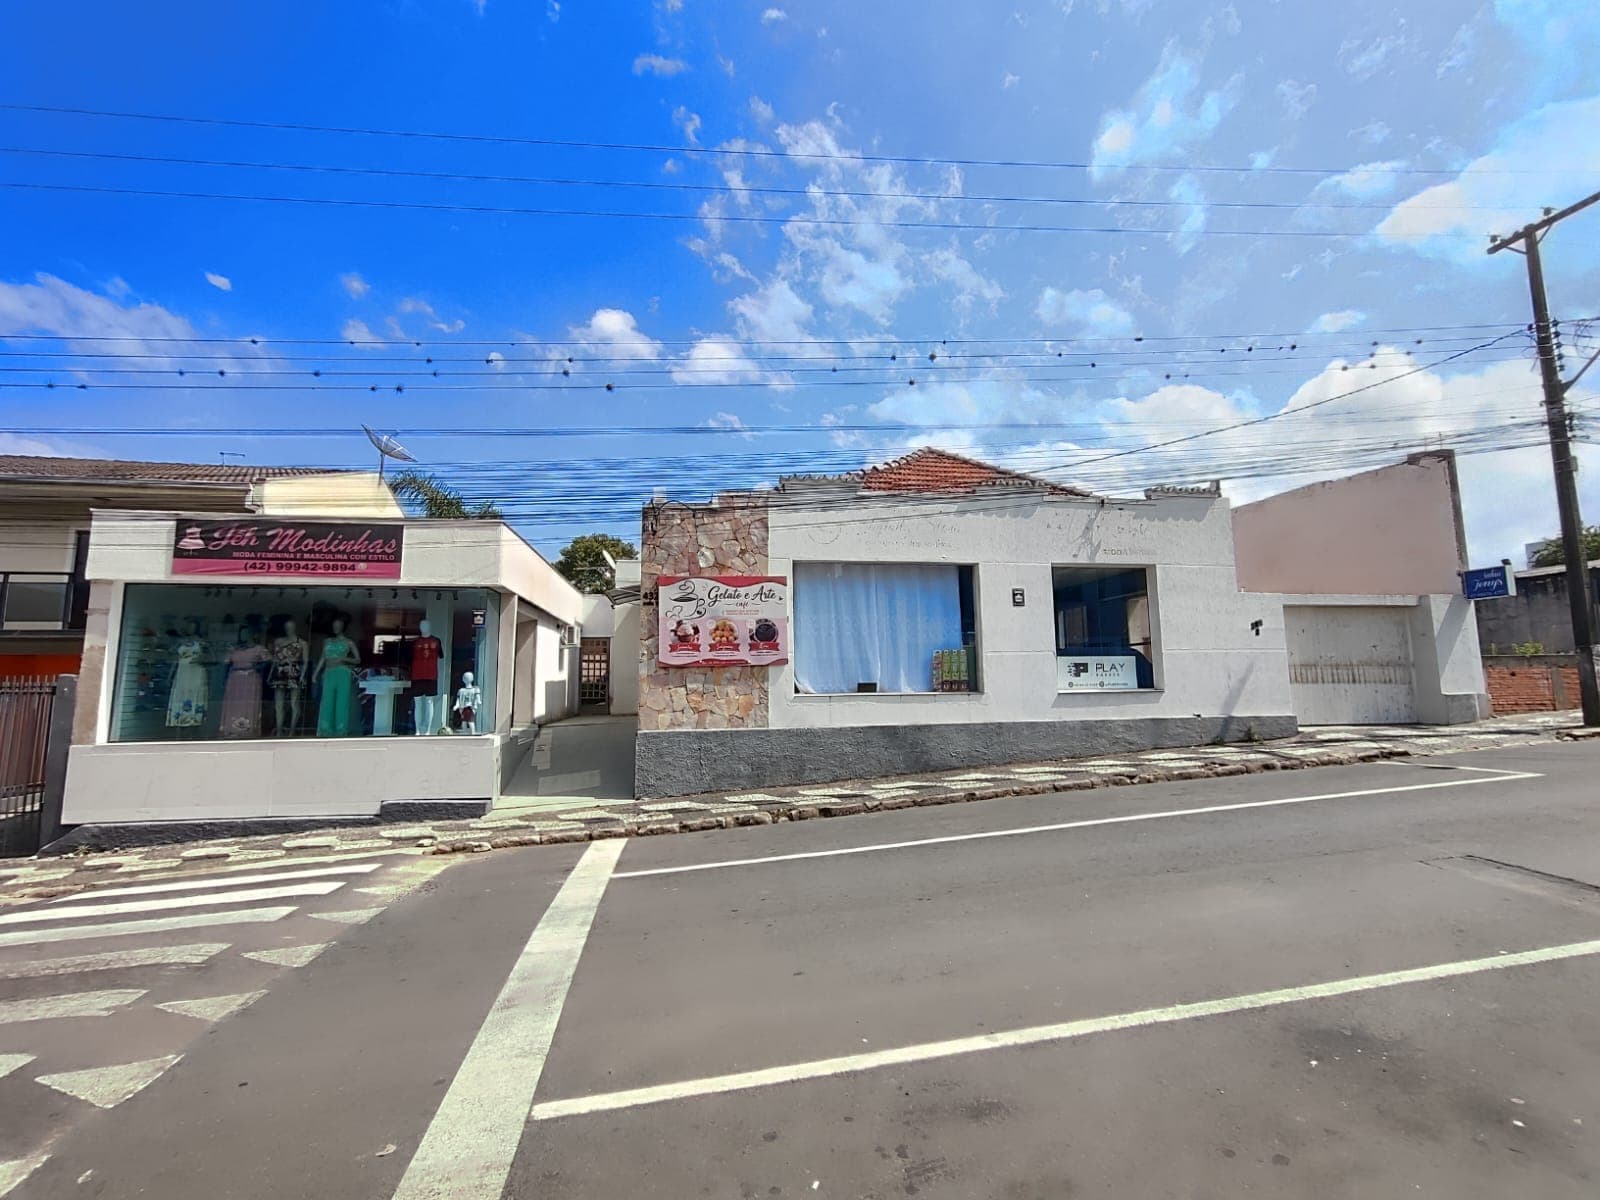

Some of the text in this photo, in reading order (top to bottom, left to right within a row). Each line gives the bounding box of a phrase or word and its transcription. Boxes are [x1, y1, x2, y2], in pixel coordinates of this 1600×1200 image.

[267, 527, 397, 553] Modinhas
[233, 551, 255, 559] MODA
[244, 562, 356, 572] (42) 99942-9894
[708, 585, 777, 607] Gelato e Arte
[1095, 663, 1126, 672] PLAY
